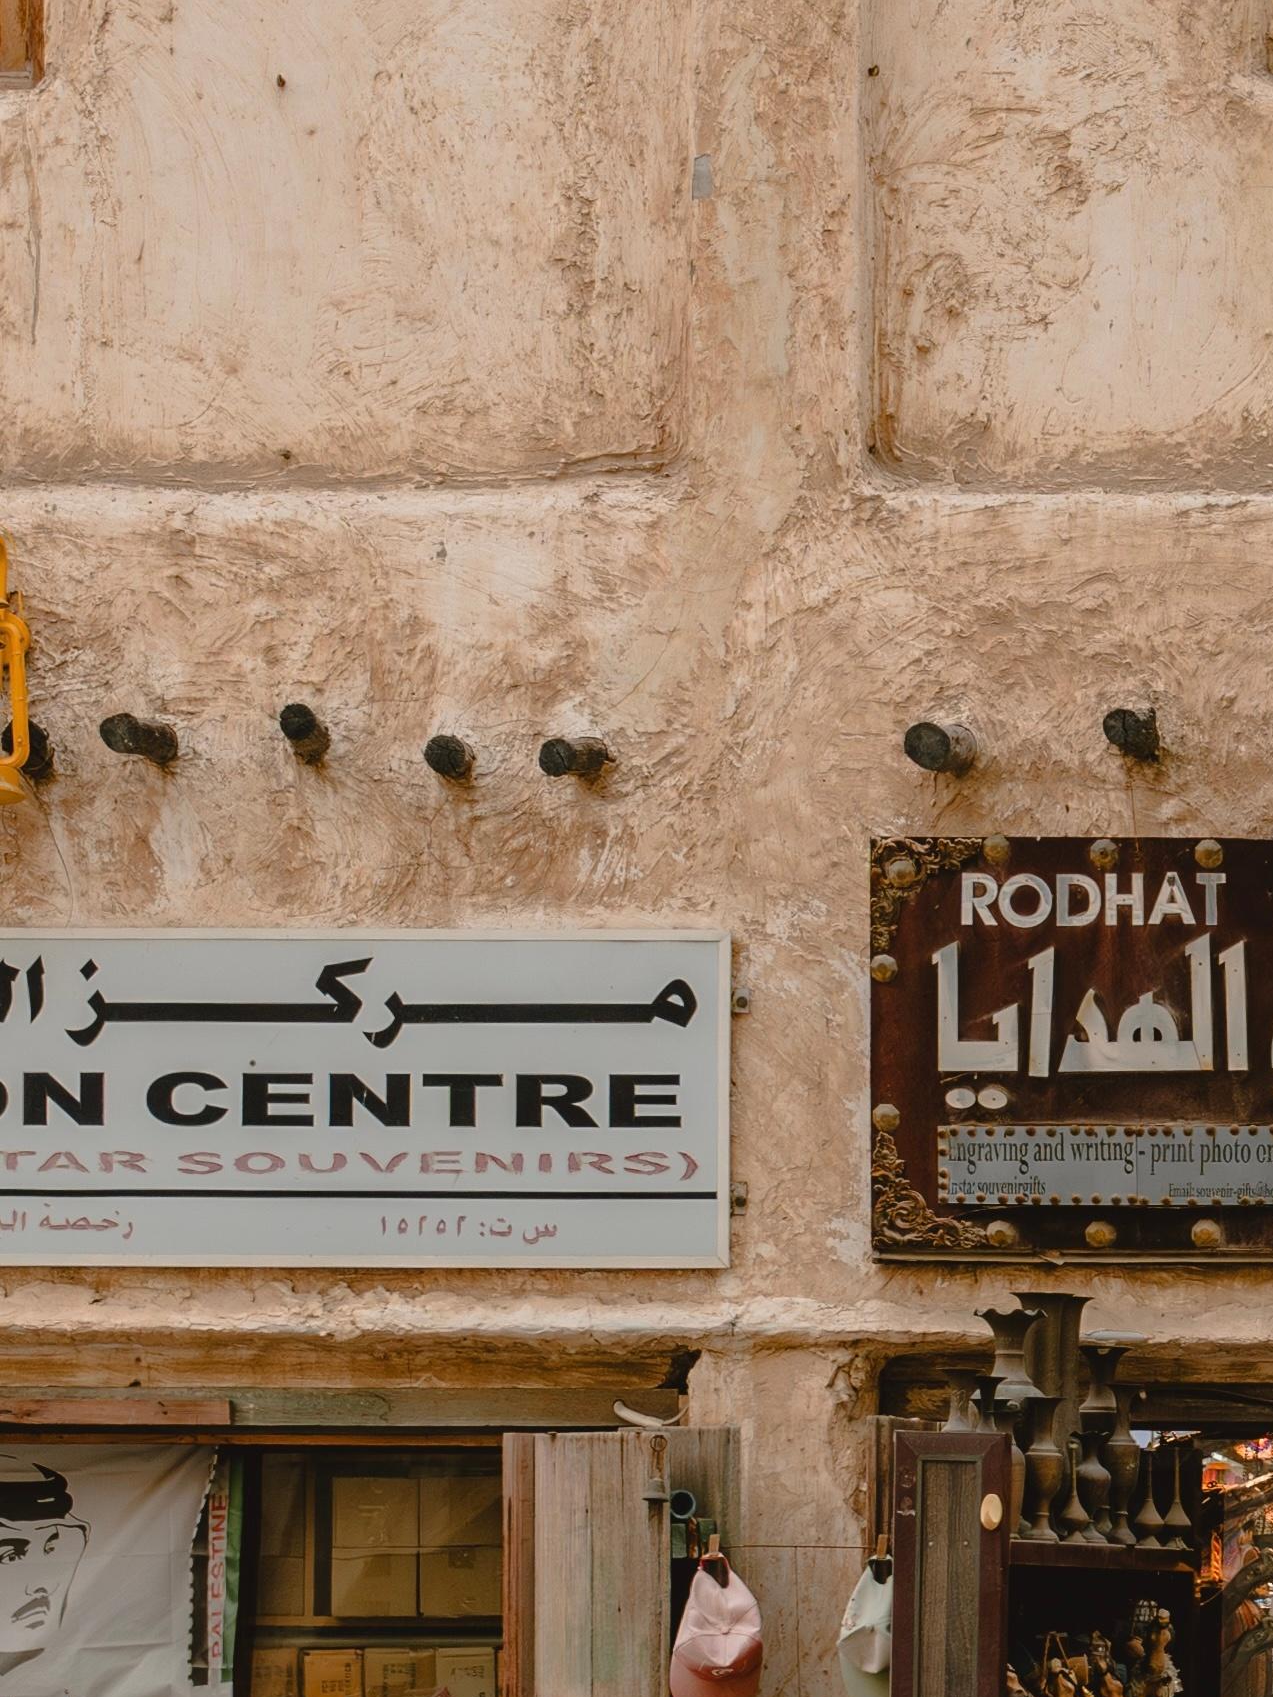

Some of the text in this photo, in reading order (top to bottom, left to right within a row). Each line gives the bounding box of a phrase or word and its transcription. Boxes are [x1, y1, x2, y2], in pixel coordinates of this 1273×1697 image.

[961, 871, 1227, 928] RODHAT
[64, 956, 698, 1049] مركز
[0, 1071, 682, 1129] N CENTRE
[947, 1132, 1030, 1176] Engraving
[1032, 1132, 1066, 1164] and
[1070, 1132, 1135, 1176] writing
[1150, 1132, 1195, 1176] print
[1199, 1132, 1252, 1176] photo
